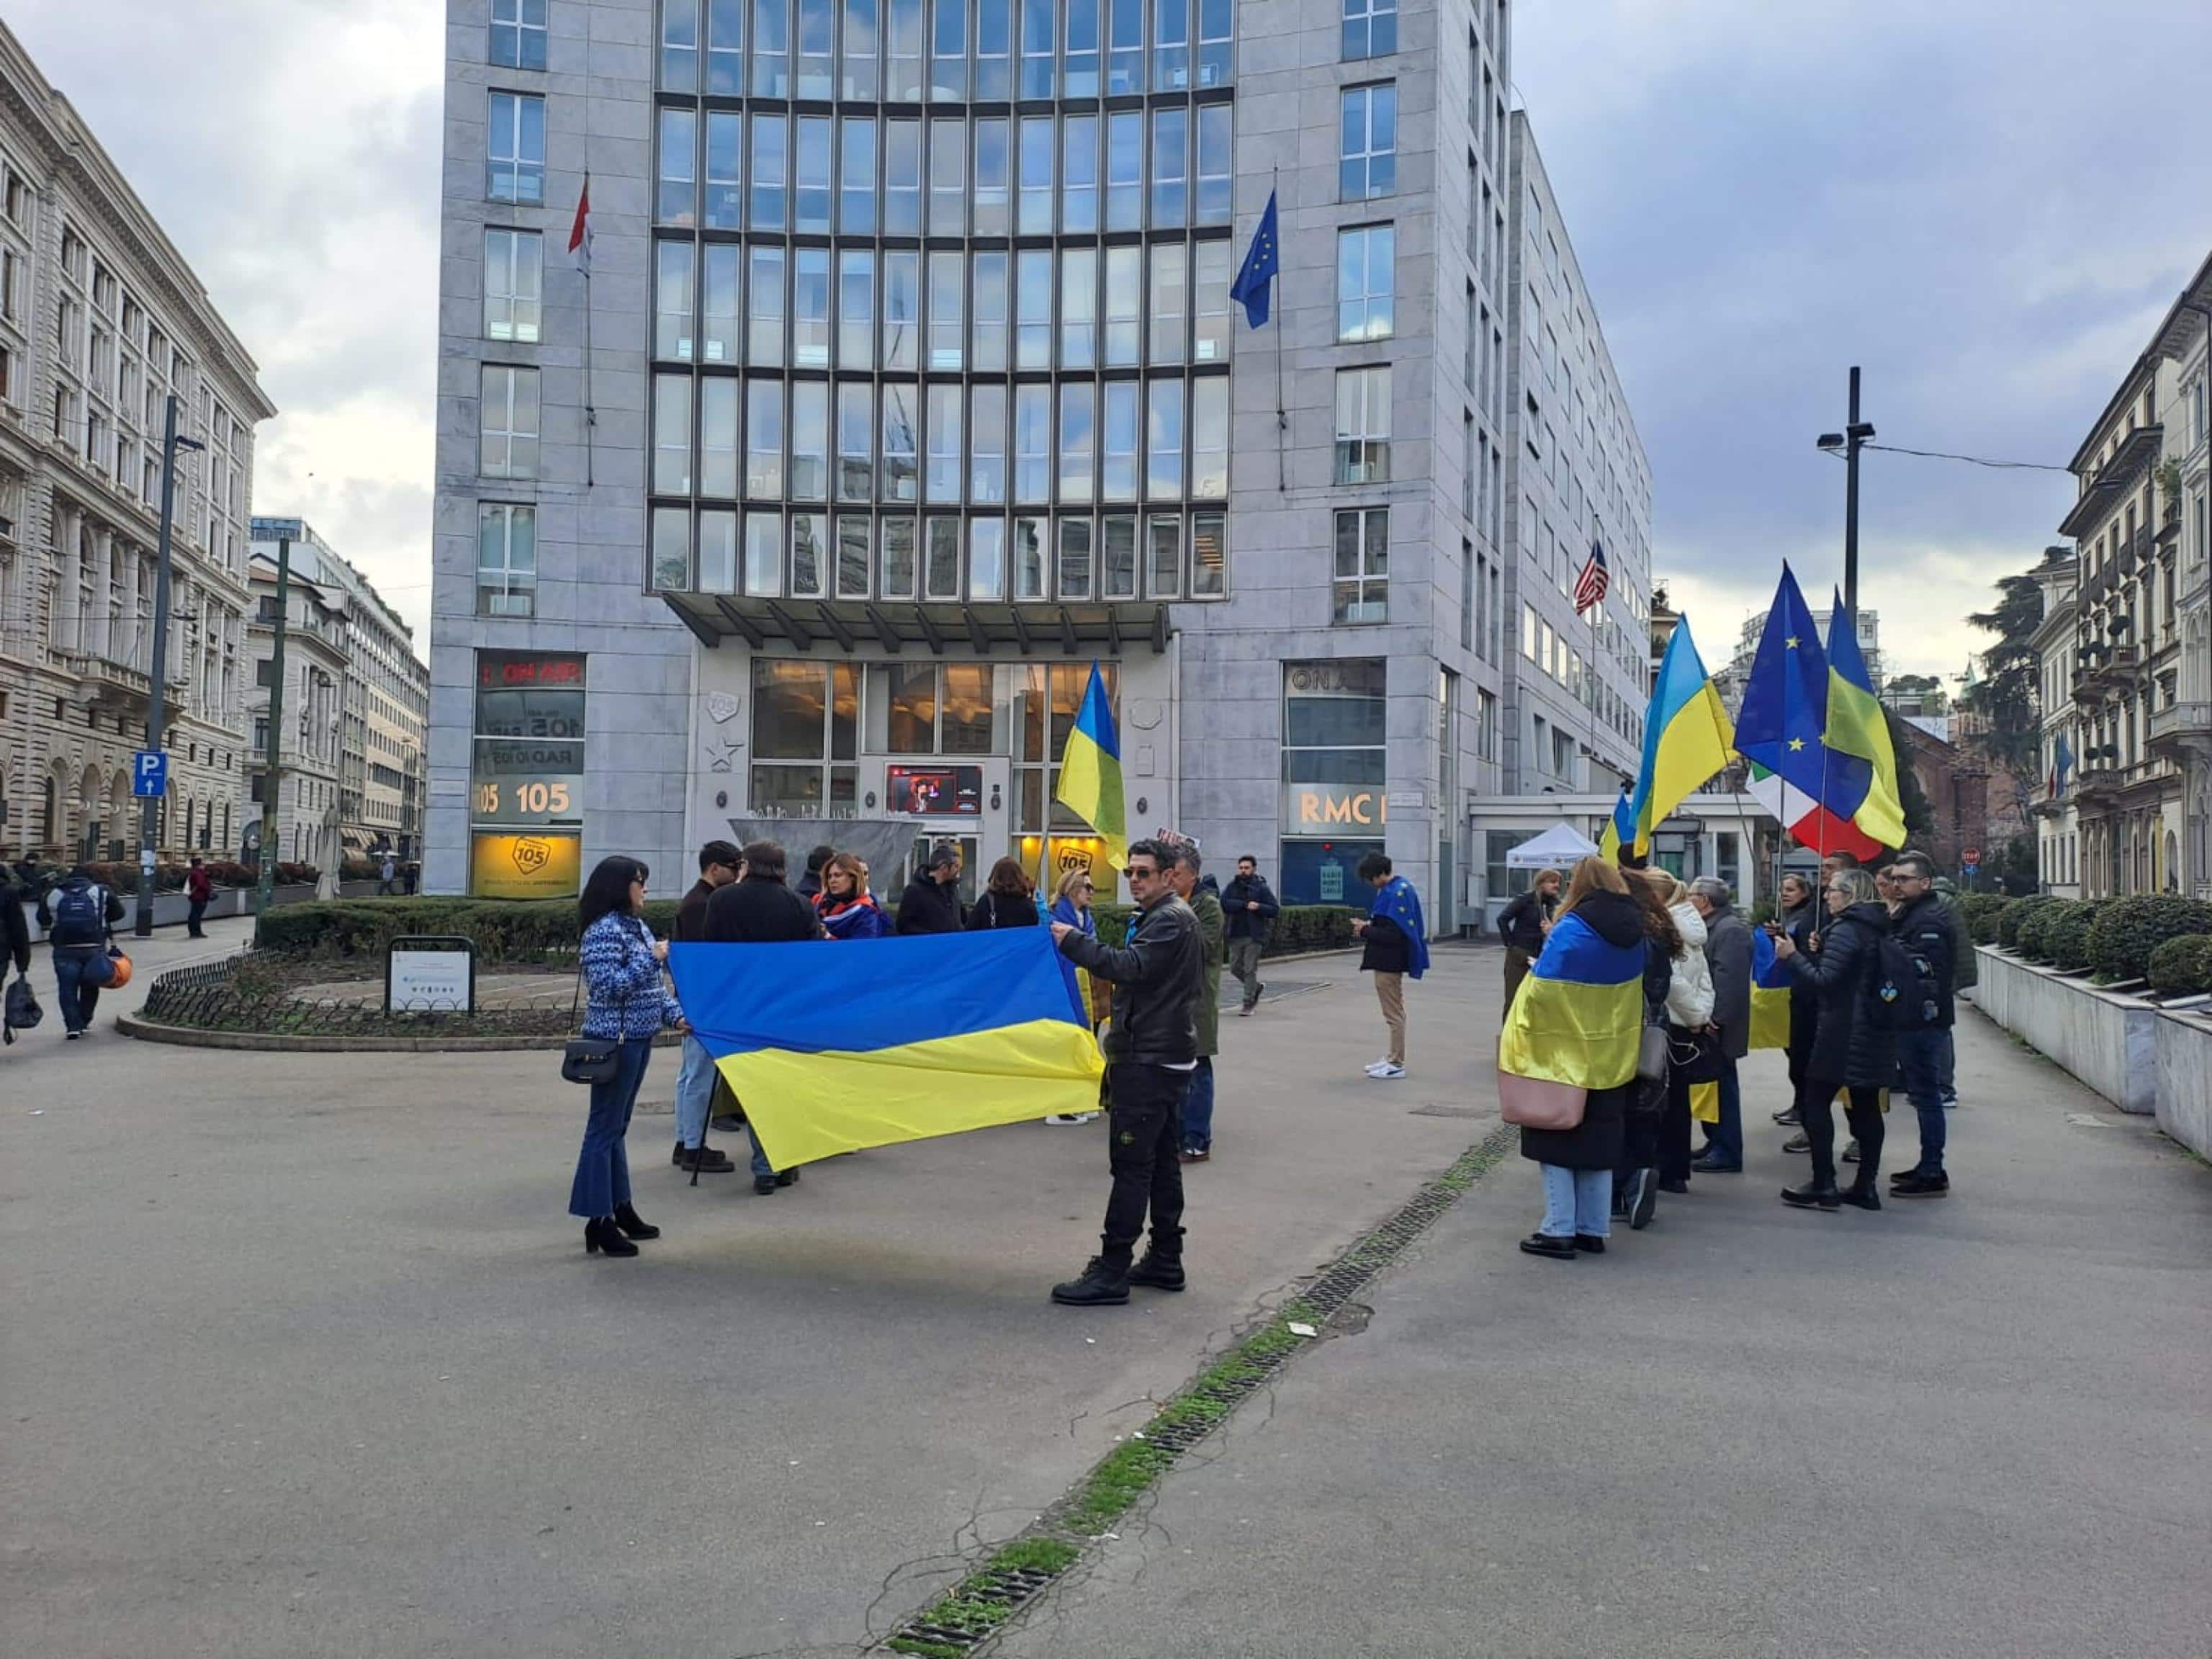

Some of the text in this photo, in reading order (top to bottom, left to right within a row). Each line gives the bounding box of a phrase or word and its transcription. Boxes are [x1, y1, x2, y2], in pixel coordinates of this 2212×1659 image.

[1292, 670, 1330, 691] ON
[141, 755, 160, 776] P
[516, 783, 570, 813] 105
[1301, 793, 1371, 824] RMC
[518, 848, 544, 865] 105
[1061, 855, 1088, 869] 105
